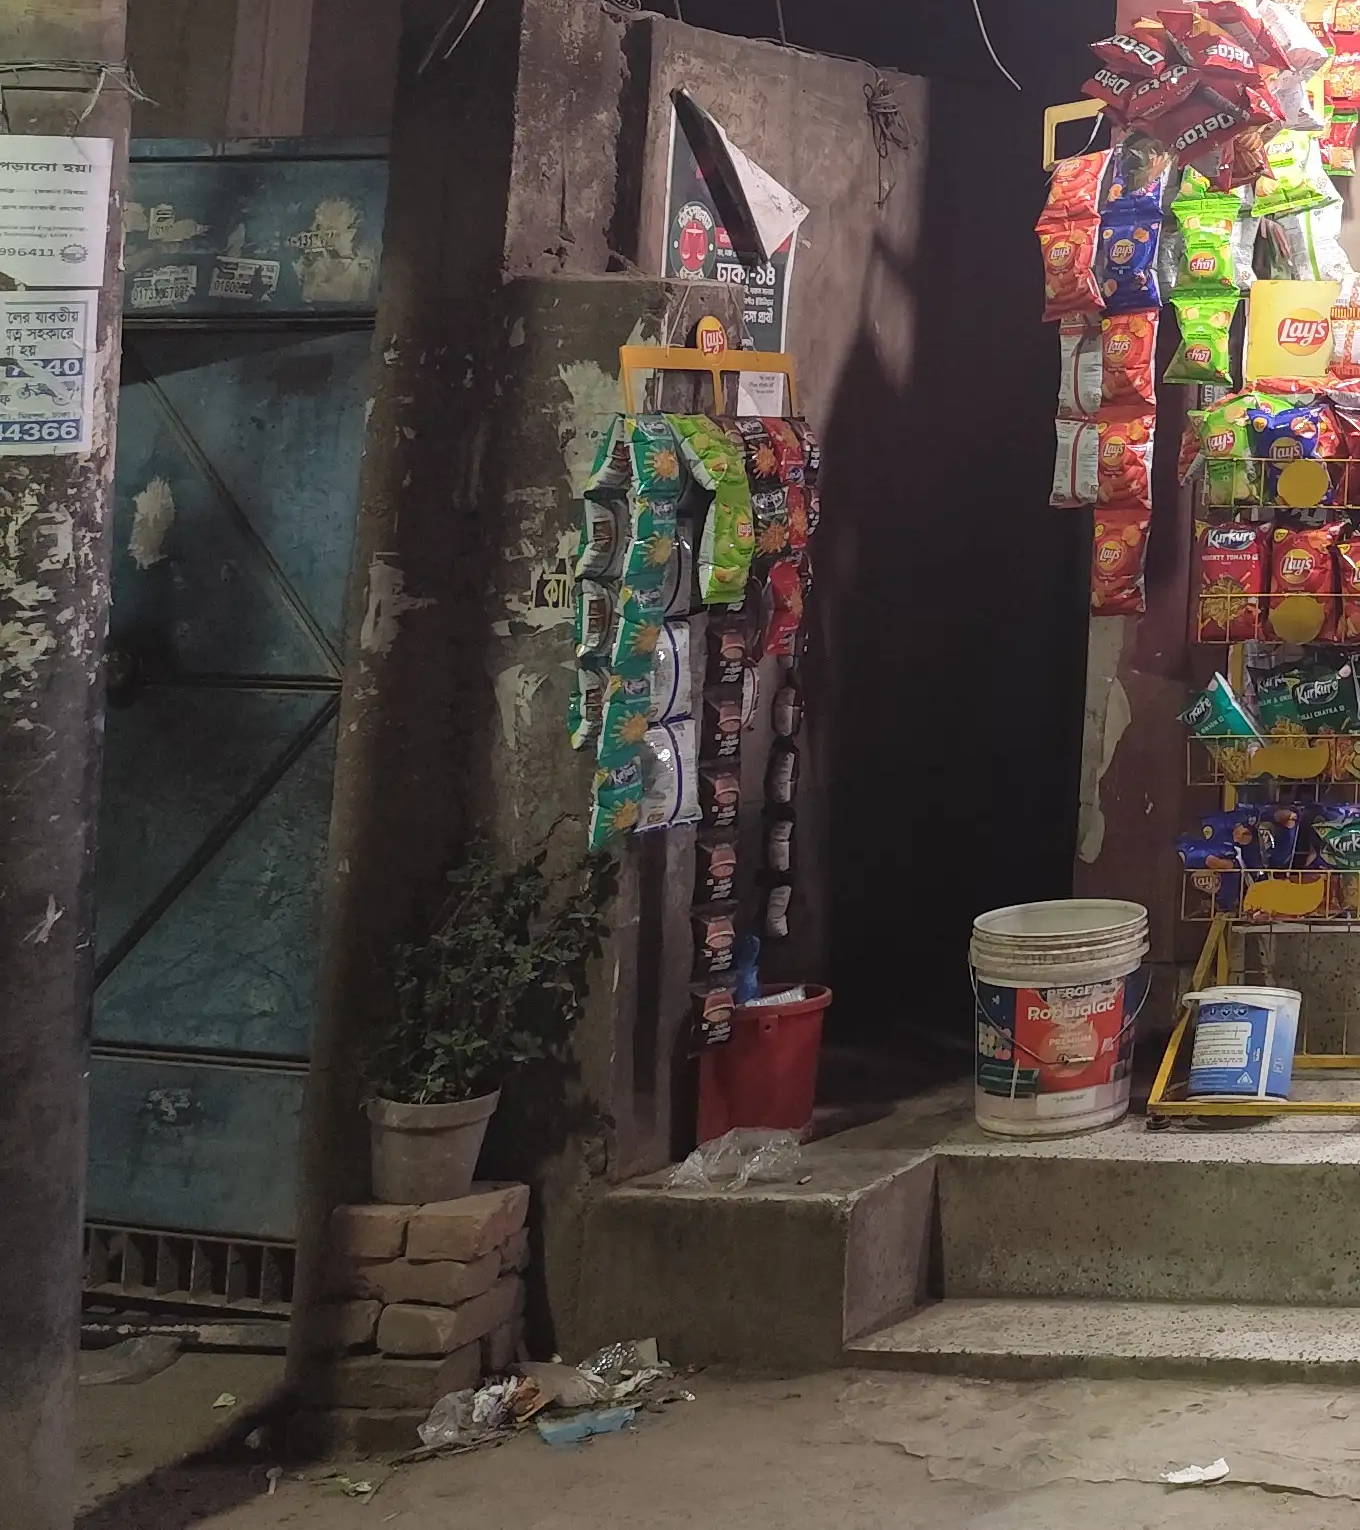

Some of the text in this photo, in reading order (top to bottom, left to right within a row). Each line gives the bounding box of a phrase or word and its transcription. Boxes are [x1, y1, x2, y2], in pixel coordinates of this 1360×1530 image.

[35, 307, 80, 324] যাবতীয়
[27, 327, 75, 342] সহকারে
[1279, 318, 1328, 347] Lay's
[0, 420, 78, 442] 4366
[1207, 528, 1257, 548] Kurkure
[1296, 679, 1339, 705] Kurkure
[1027, 999, 1116, 1021] Robbialac
